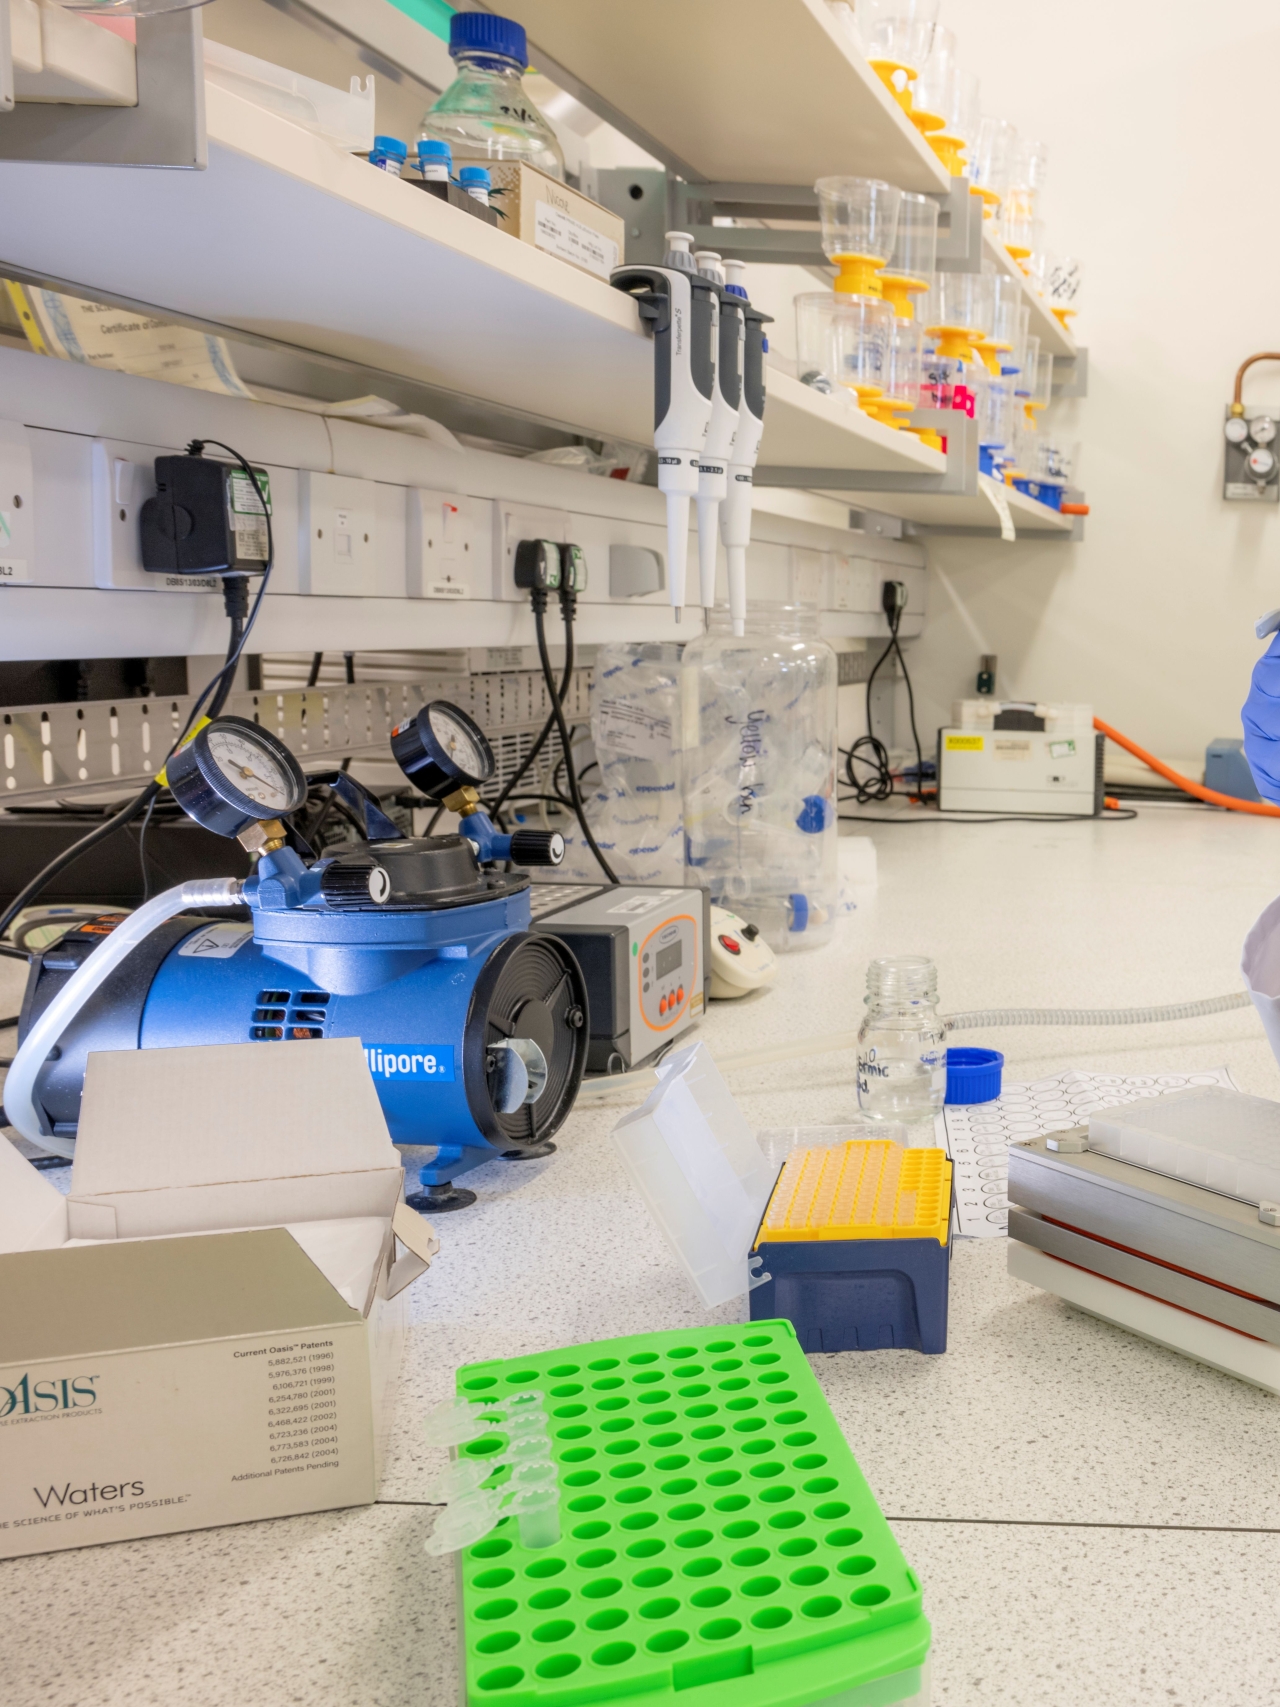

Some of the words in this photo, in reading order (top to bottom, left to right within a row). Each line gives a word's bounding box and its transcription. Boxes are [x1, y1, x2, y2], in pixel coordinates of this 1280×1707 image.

[100, 321, 141, 335] Certificate
[233, 1348, 267, 1358] Current
[300, 1340, 334, 1350] Patents
[268, 1356, 307, 1366] 5,882,521
[308, 1352, 334, 1362] (1996)
[268, 1368, 307, 1378] 5,976,376
[309, 1364, 335, 1374] (1998)
[272, 1380, 308, 1390] 6,106,721
[309, 1376, 335, 1386] (1999)
[268, 1392, 308, 1404] 6,254,780
[310, 1388, 336, 1398] (2001)
[268, 1404, 309, 1416] 6,322,695
[311, 1400, 336, 1410] (2001)
[11, 1413, 60, 1426] EXTRACTION
[62, 1407, 103, 1419] PRODUCTS
[268, 1416, 308, 1428] 6,468,422
[310, 1412, 337, 1422] (2002)
[269, 1428, 309, 1440] 6,723,236
[311, 1424, 338, 1434] (2004)
[270, 1440, 309, 1452] 6,773,583
[311, 1436, 338, 1446] (2004)
[270, 1452, 310, 1464] 6,726,842
[311, 1448, 339, 1458] (2004)
[231, 1470, 272, 1482] Additional
[274, 1465, 305, 1476] Patents
[306, 1460, 339, 1471] Pending
[33, 1480, 145, 1509] Waters
[13, 1514, 62, 1528] SCIENCE
[65, 1511, 80, 1521] OF
[83, 1504, 126, 1517] WHAT'S
